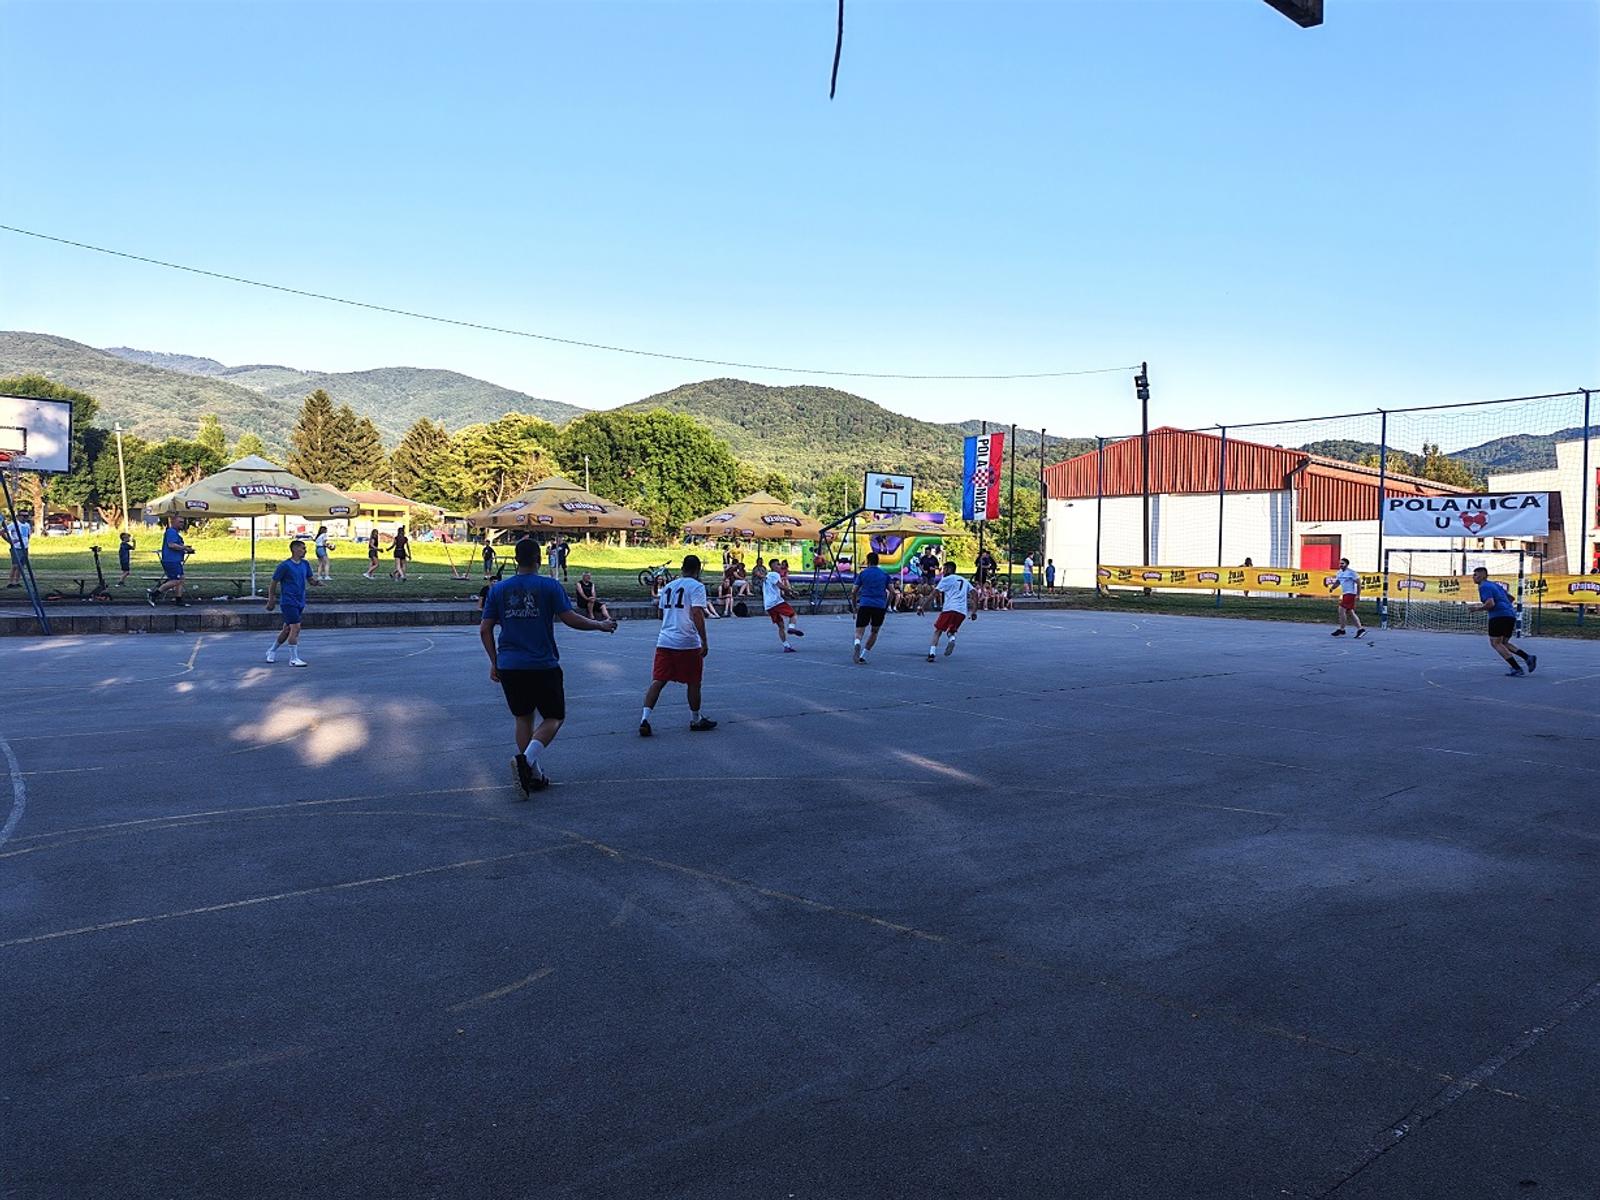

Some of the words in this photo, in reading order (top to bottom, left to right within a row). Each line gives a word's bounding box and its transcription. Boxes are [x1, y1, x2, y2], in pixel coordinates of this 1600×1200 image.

[1435, 517, 1451, 529] U
[957, 579, 964, 591] 7
[664, 587, 685, 608] 11
